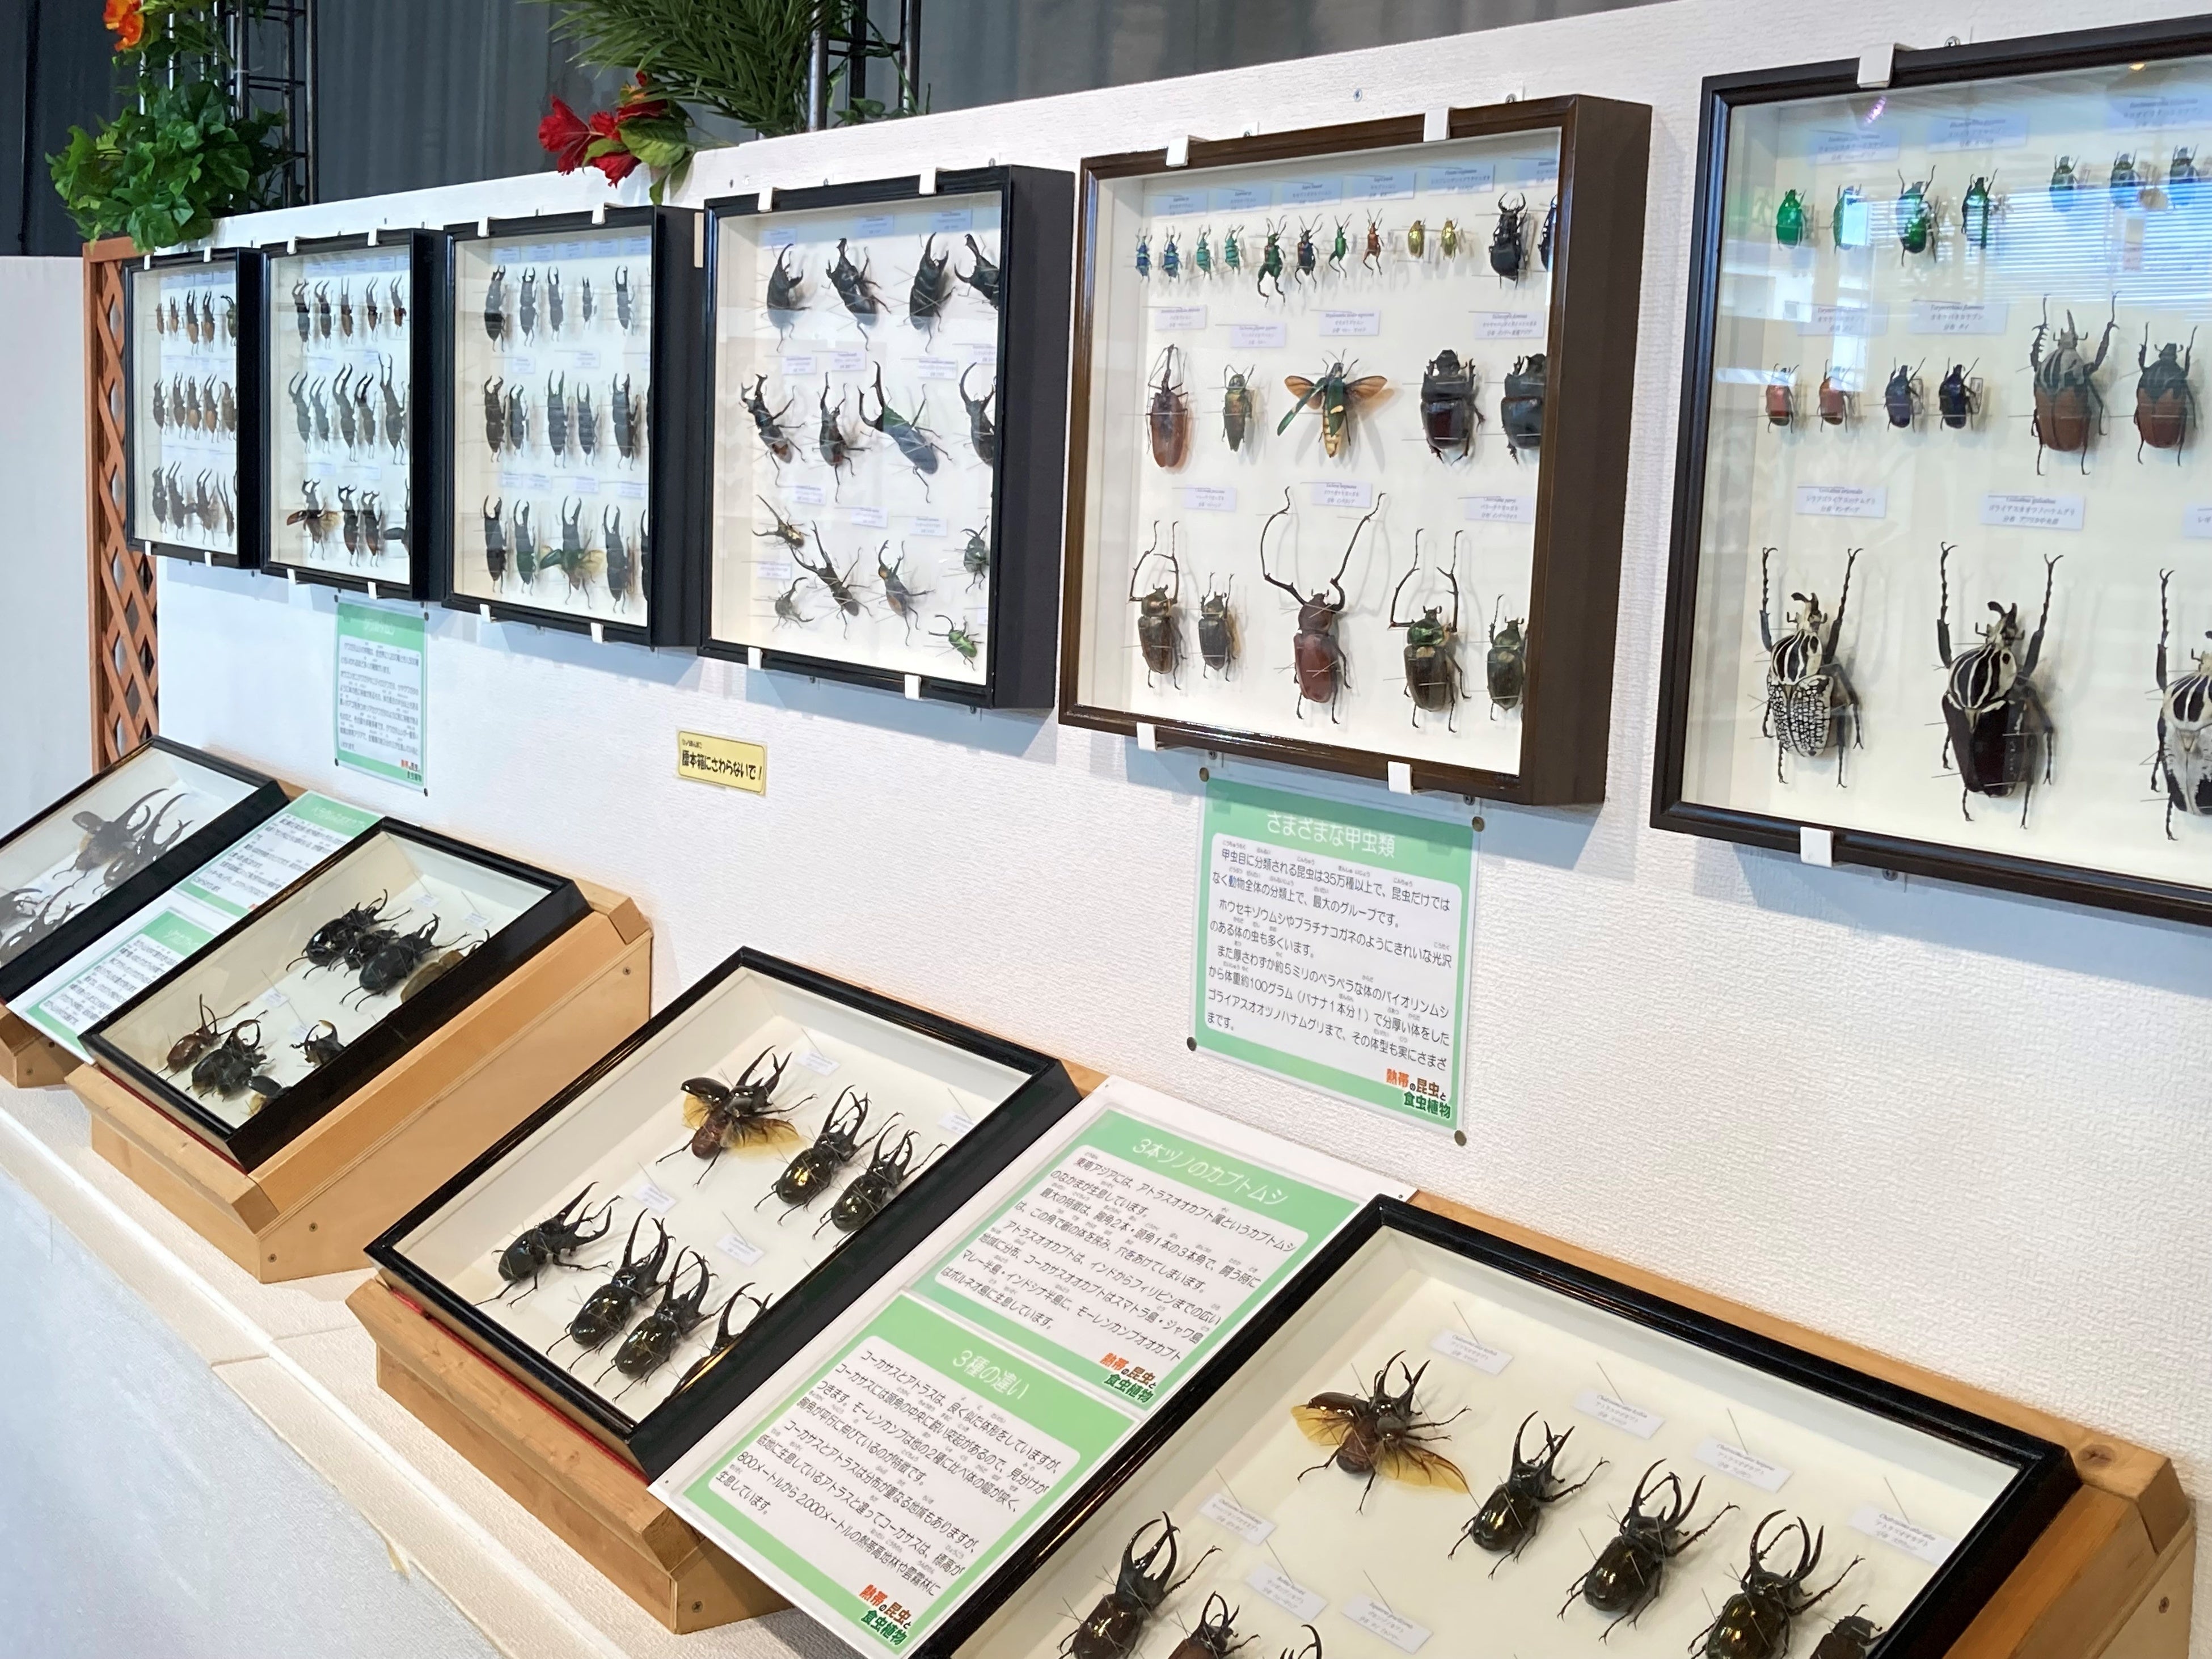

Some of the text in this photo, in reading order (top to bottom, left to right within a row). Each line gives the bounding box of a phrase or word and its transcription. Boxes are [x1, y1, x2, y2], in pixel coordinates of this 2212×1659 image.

[1267, 811, 1395, 858] さまざまな甲虫類
[1210, 921, 1314, 958] のある体の虫も多くいます。
[1208, 1011, 1234, 1031] まです。
[1386, 1067, 1446, 1101] 熱帯の昆虫と
[1403, 1091, 1451, 1120] 食虫植物
[952, 1349, 1029, 1400] 3種の違い
[1099, 1352, 1156, 1390] 熱帯の昆虫と
[1103, 1372, 1154, 1404] 食虫植物
[716, 1470, 771, 1515] 生息しています。
[858, 1584, 911, 1630] 熱帯の昆虫と
[860, 1608, 909, 1647] 食虫植物
